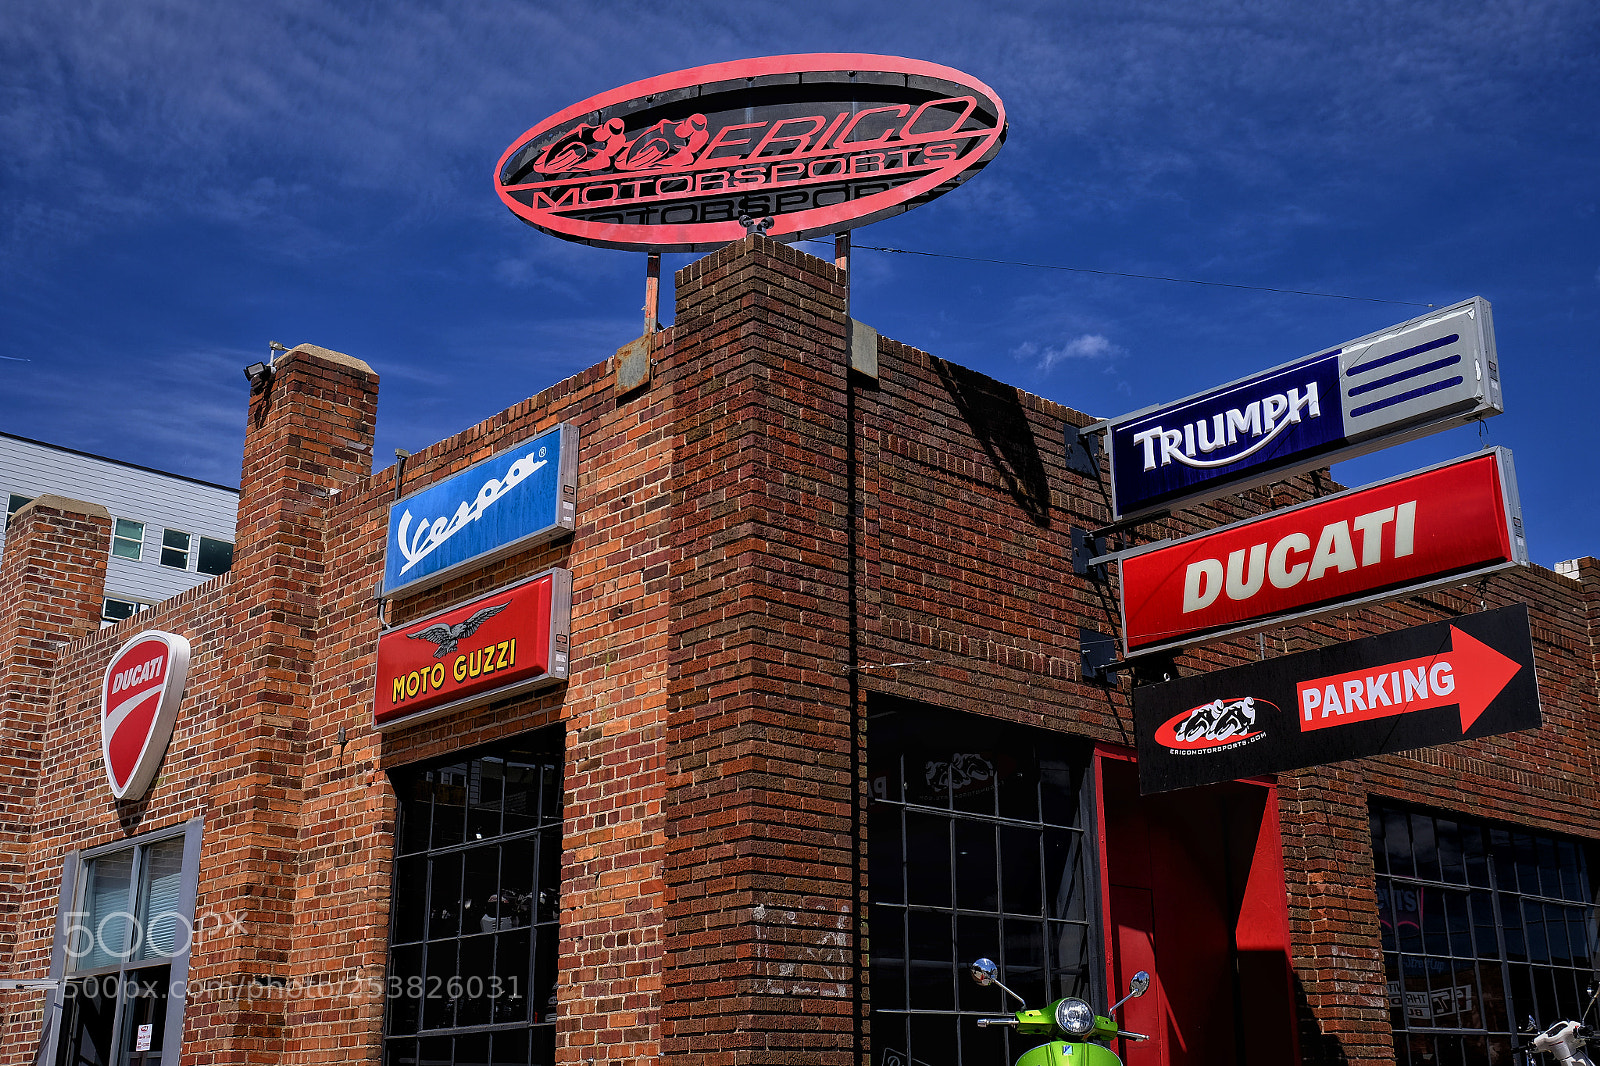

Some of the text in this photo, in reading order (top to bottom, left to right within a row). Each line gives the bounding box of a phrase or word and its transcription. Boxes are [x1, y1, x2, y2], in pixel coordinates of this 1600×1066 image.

[694, 96, 977, 165] ERICO
[532, 143, 958, 210] MOTORSPORTS
[1133, 381, 1321, 472] TRIUMPH
[398, 452, 548, 577] Vespa
[1182, 500, 1417, 613] DUCATI
[111, 655, 164, 694] DUCATI
[392, 638, 517, 703] MOTO GUZZI
[1302, 661, 1456, 722] PARKING
